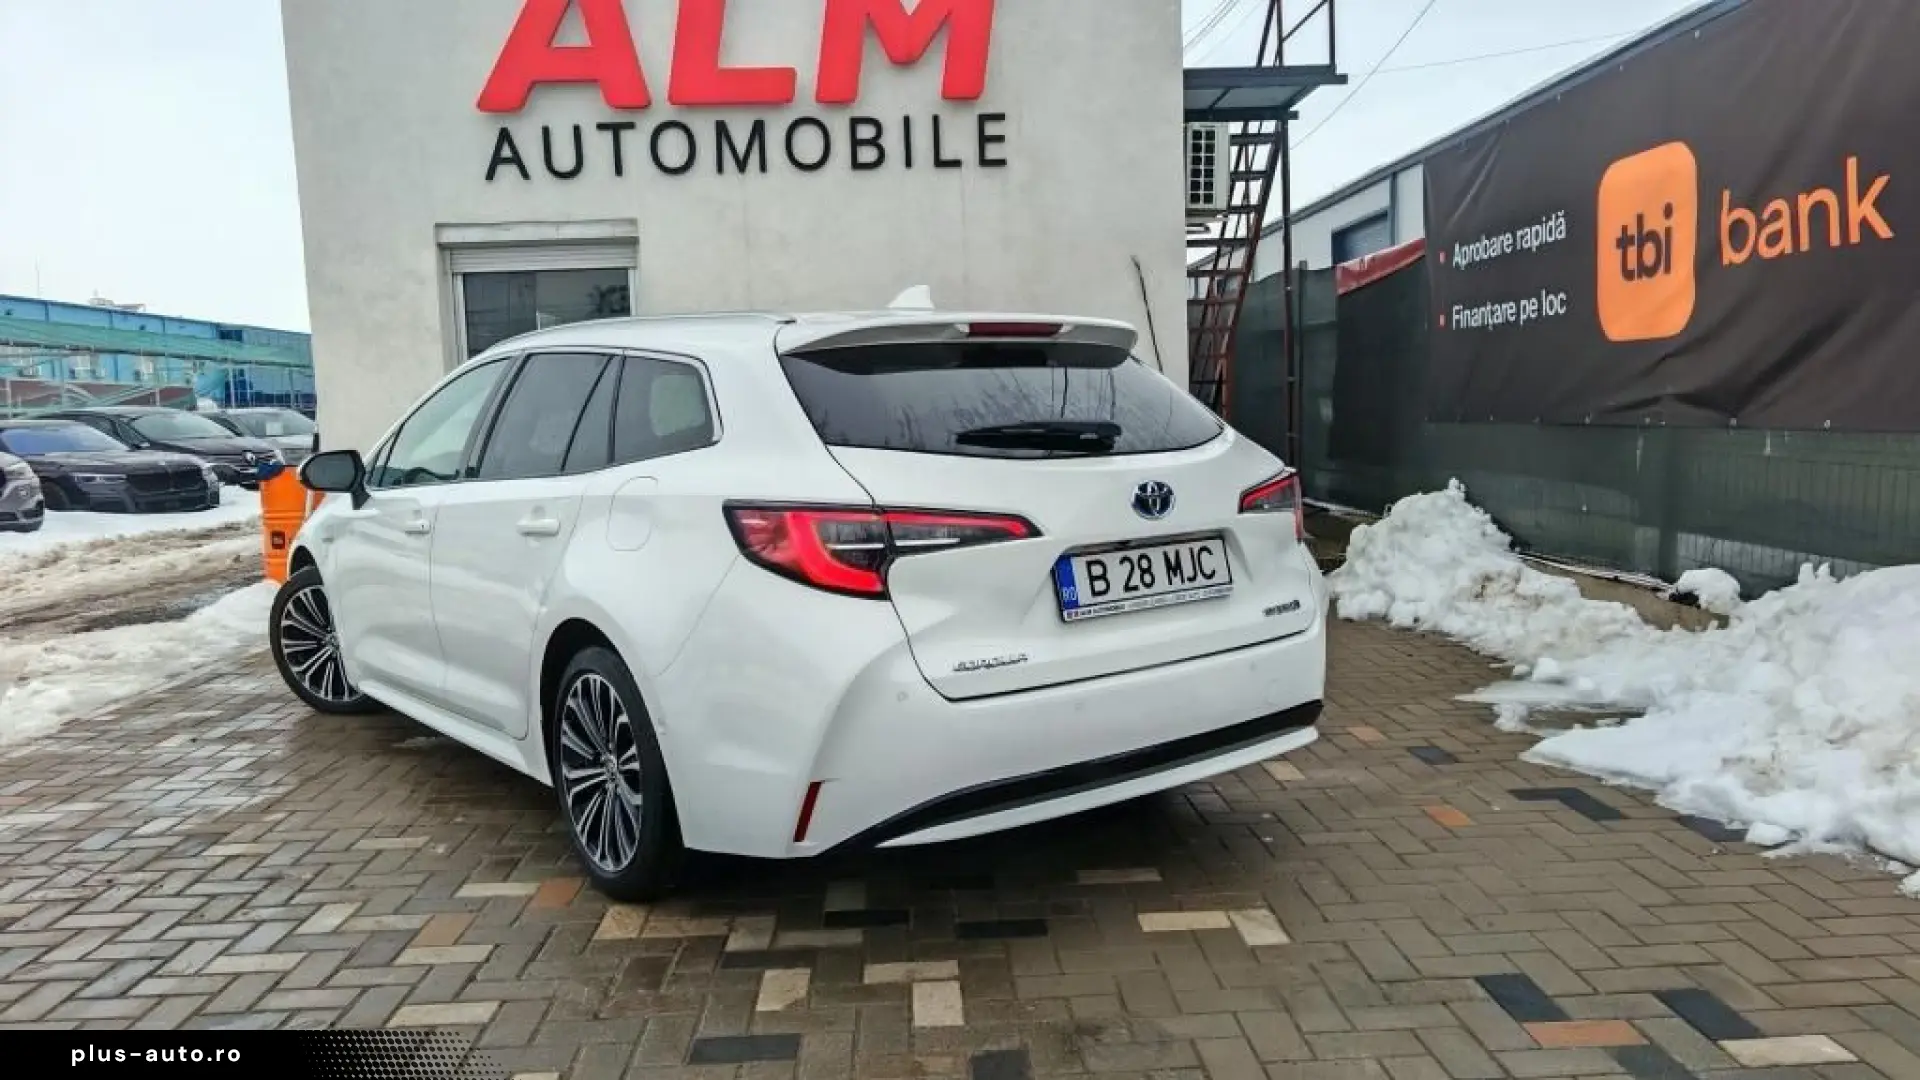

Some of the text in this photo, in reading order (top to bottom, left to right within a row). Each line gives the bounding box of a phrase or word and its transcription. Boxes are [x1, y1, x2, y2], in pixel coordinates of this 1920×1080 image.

[476, 0, 996, 113] ALM
[485, 112, 1007, 181] AUTOMOBILE
[1452, 209, 1567, 270] Aprobare rapidă
[1615, 155, 1895, 282] tbi bank
[1519, 297, 1539, 326] pe
[1541, 288, 1567, 317] loc
[1085, 545, 1216, 597] B 28 MJC
